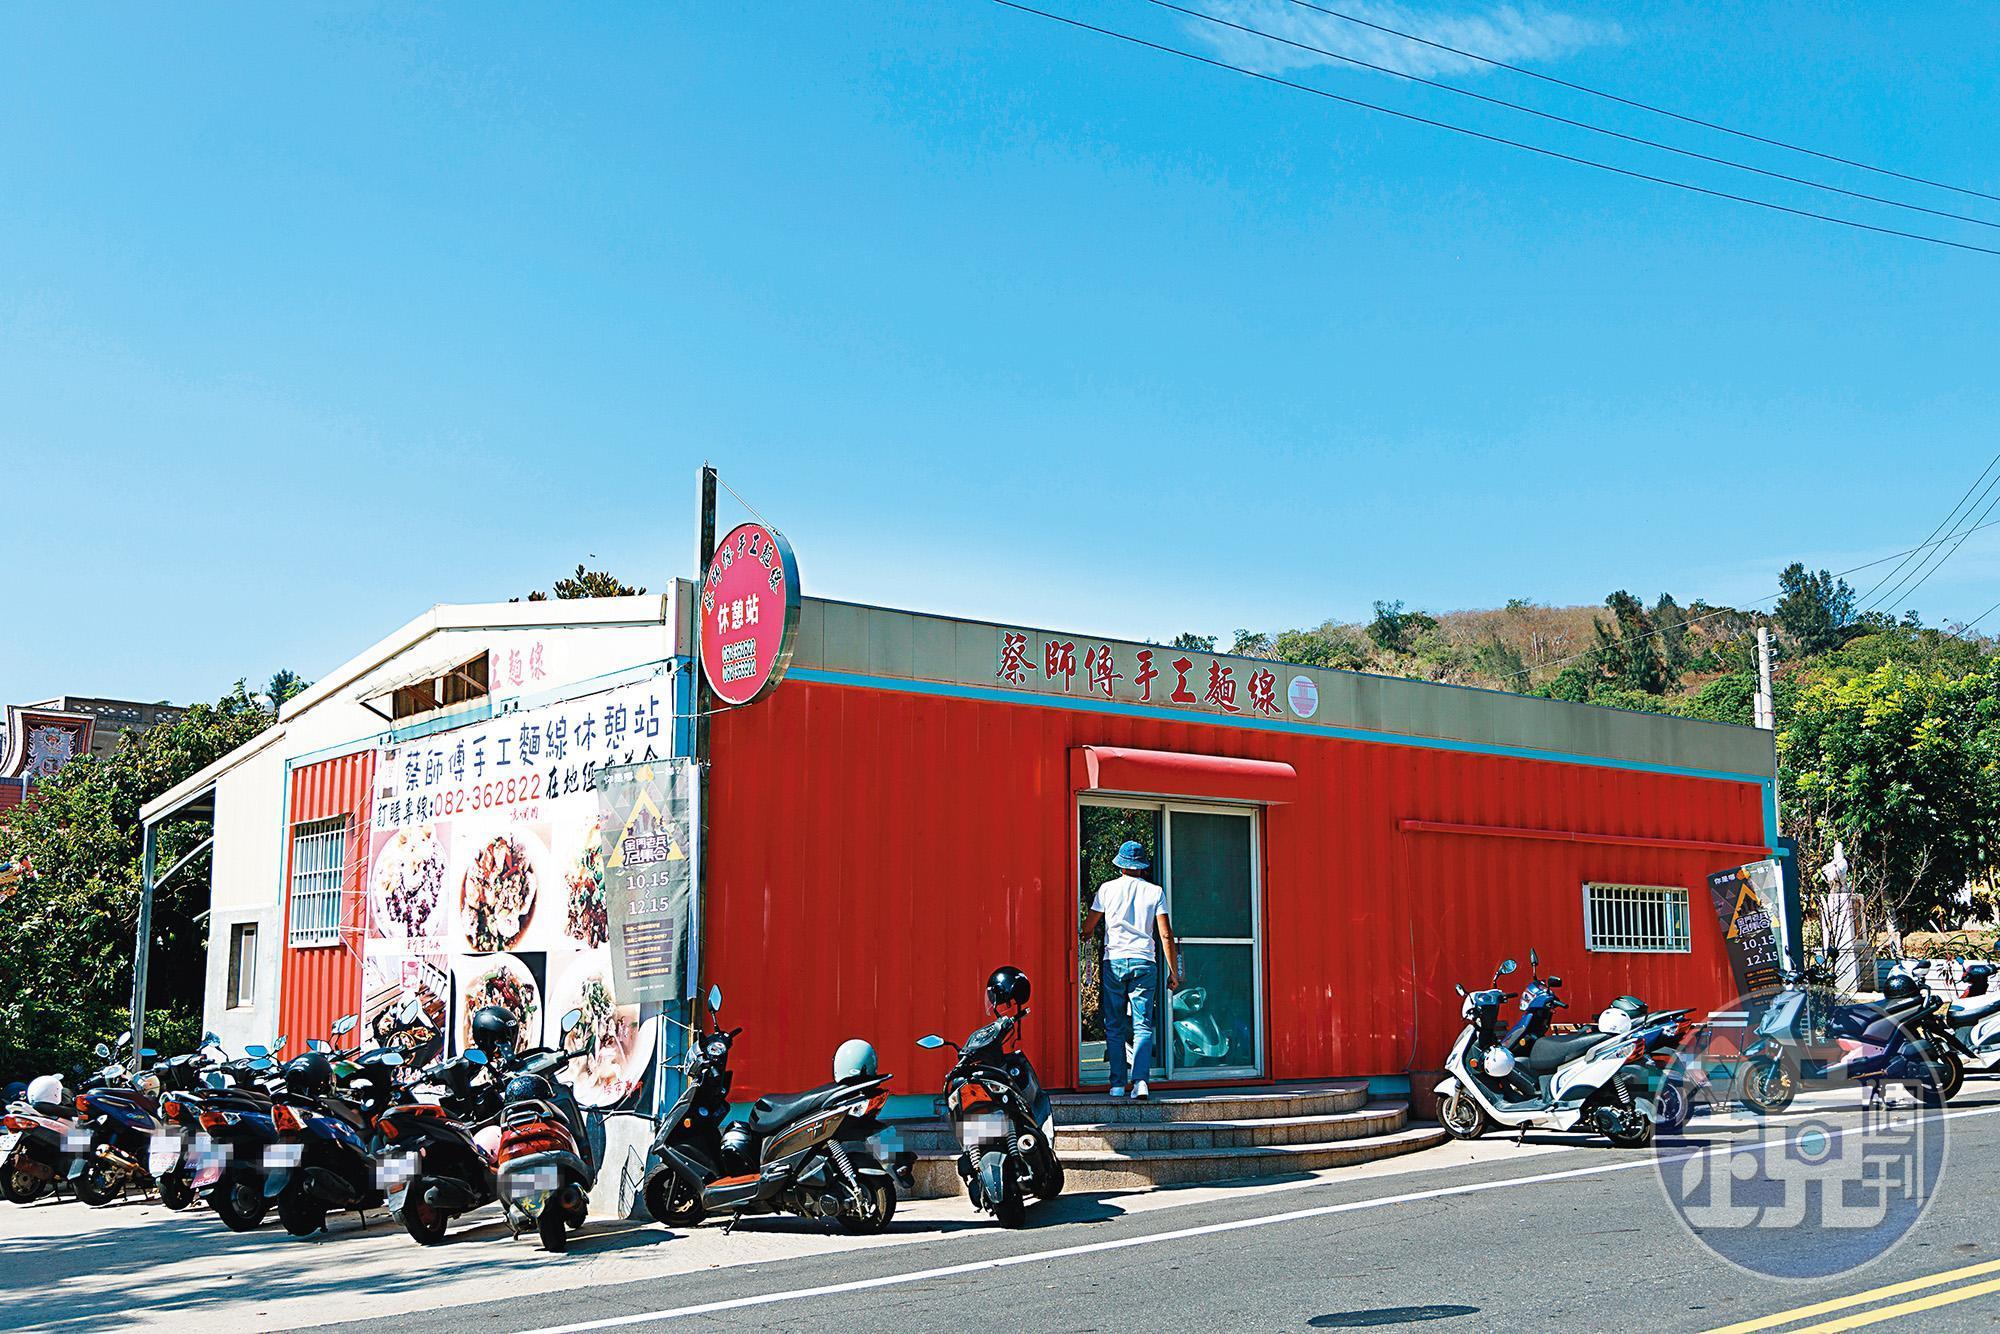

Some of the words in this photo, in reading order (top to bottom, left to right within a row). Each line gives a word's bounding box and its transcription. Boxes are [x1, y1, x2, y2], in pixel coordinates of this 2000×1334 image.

[717, 593, 760, 635] 休憩站
[996, 631, 1283, 718] 蔡師傅手工麵線
[405, 695, 660, 791] 蔡師傅手工麵線休憩站
[627, 871, 670, 890] 10.15
[629, 897, 670, 916] 12.15
[1742, 934, 1776, 951] 10.15
[1746, 951, 1778, 967] 12.15
